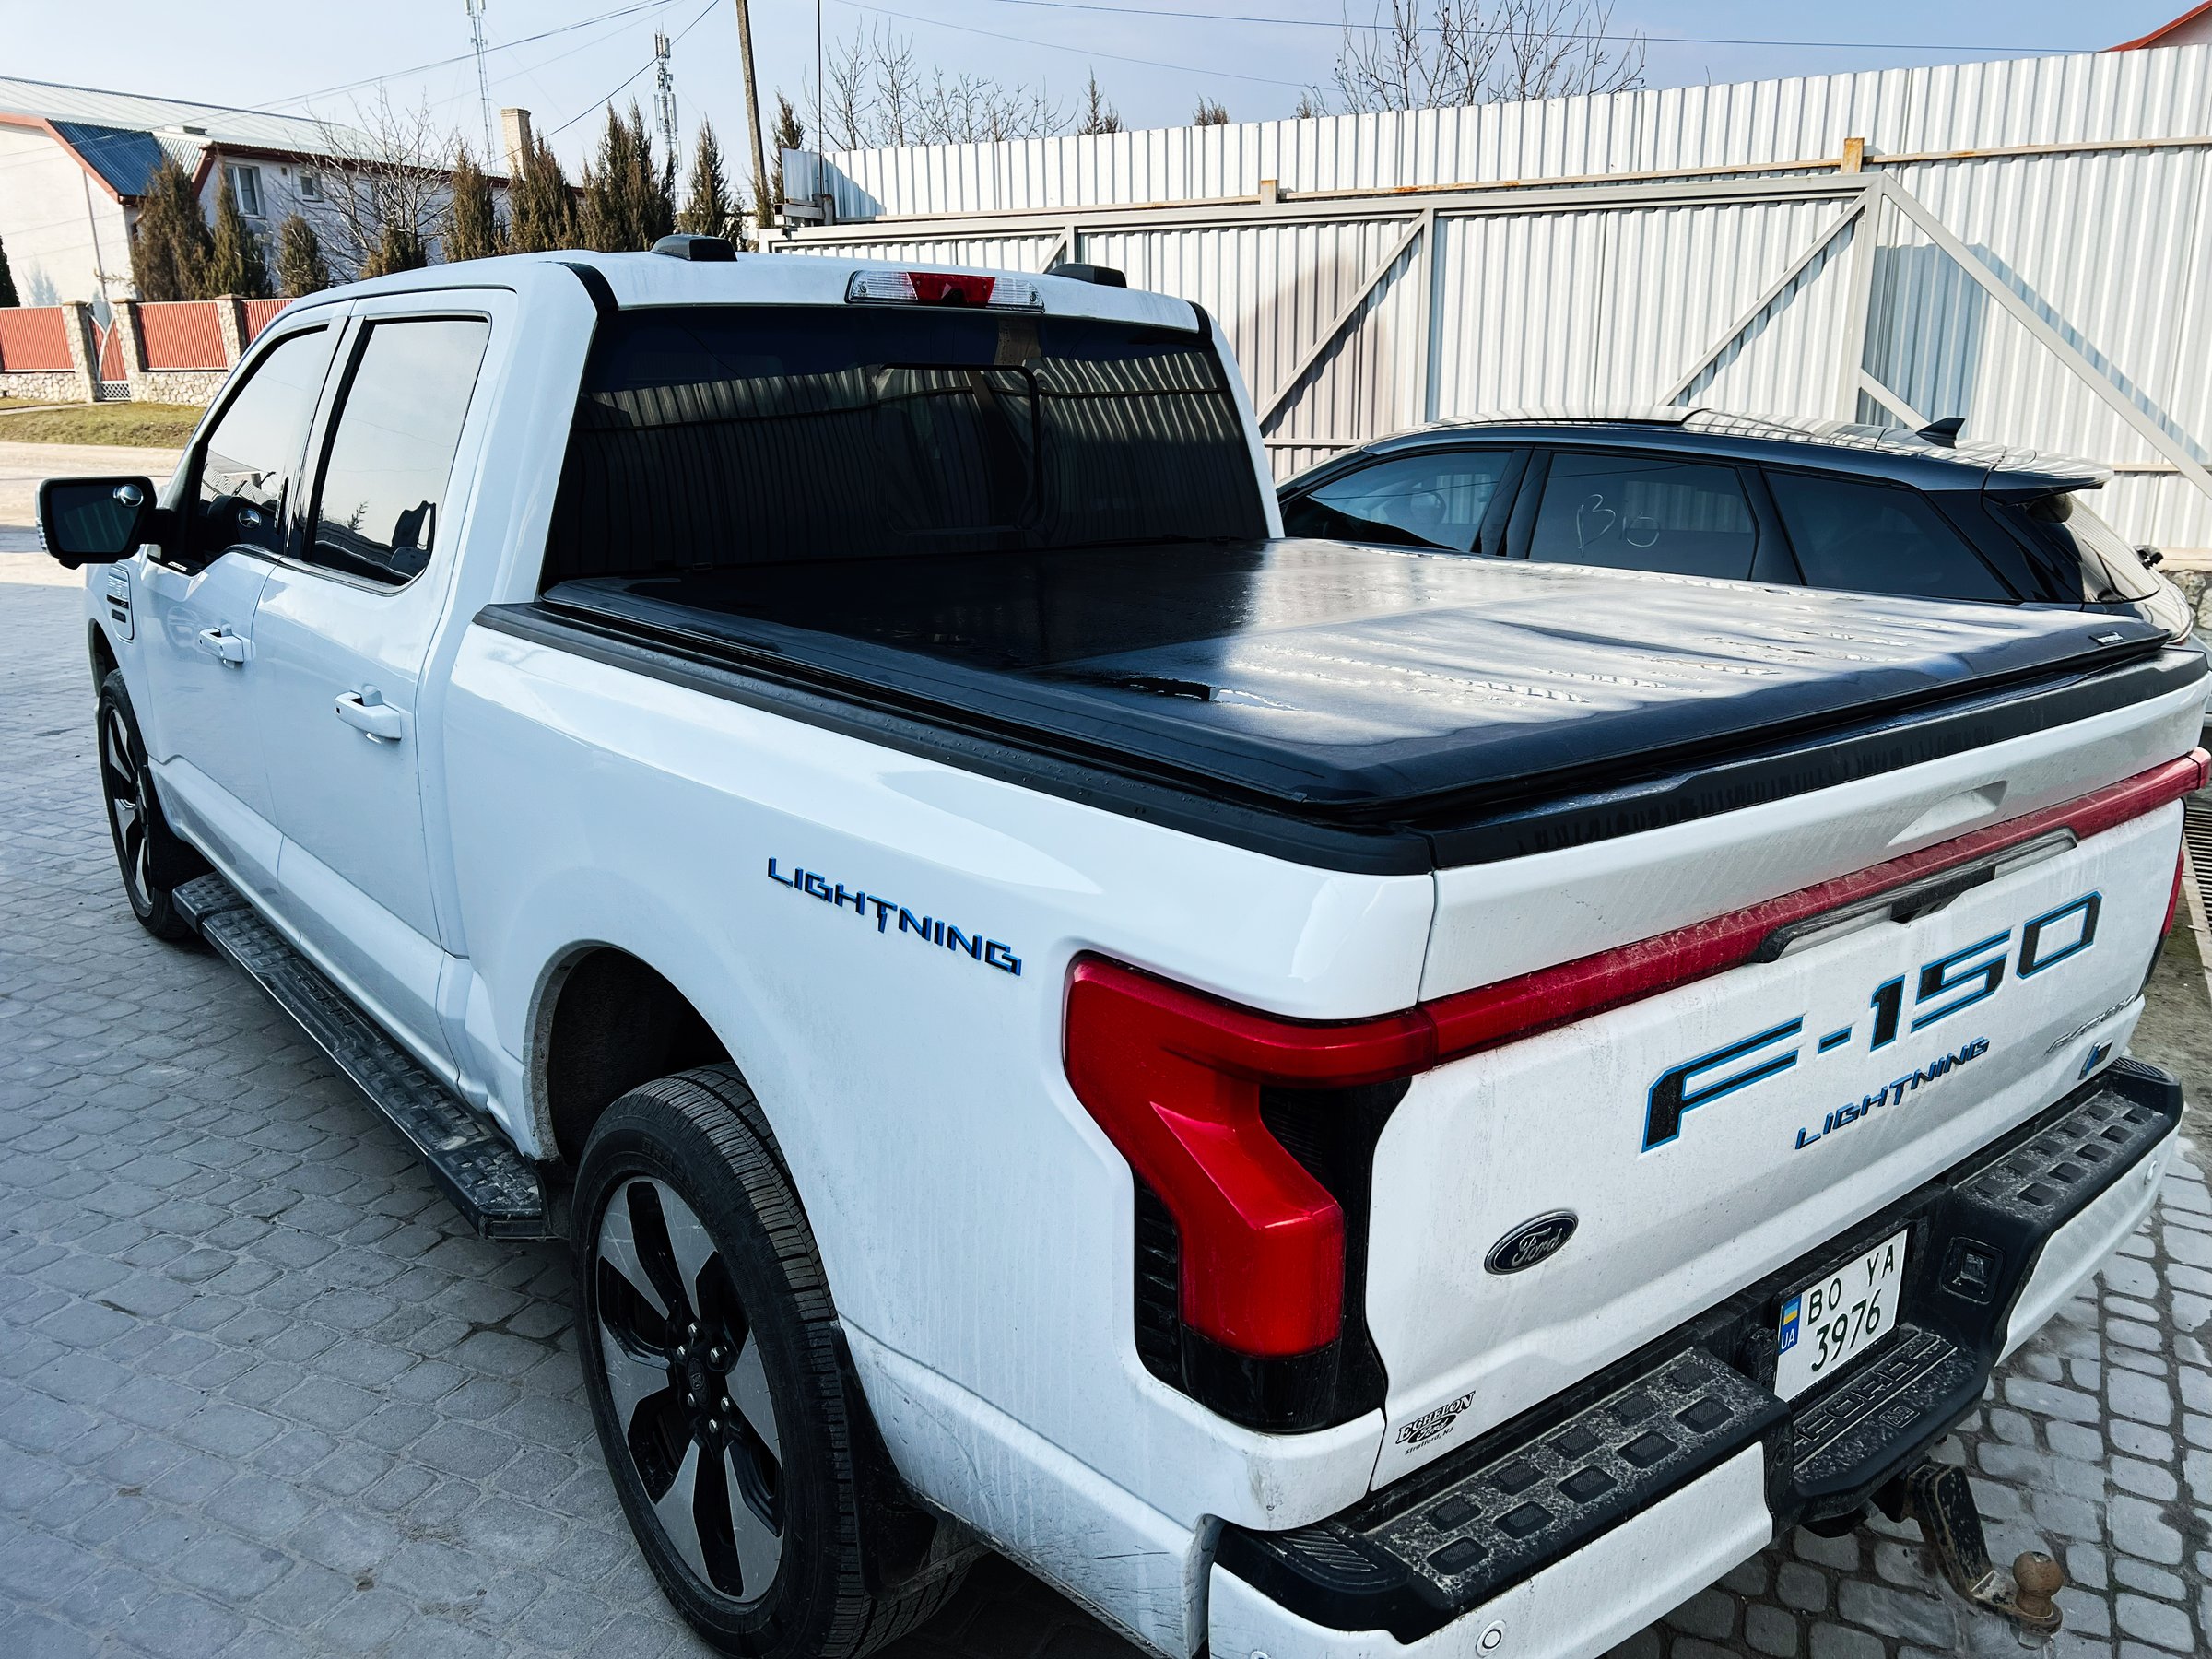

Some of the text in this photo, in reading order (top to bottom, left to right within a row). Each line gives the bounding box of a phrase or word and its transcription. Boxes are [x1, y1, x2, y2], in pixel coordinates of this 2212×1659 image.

[767, 856, 1022, 977] LIGHTNING
[1641, 890, 2102, 1153] F-150
[1795, 1036, 1989, 1150] LIGHTNING
[1512, 1227, 1562, 1266] Ford
[1807, 1244, 1894, 1326] BO YA
[1781, 1328, 1795, 1350] UA
[1811, 1288, 1882, 1371] 3976
[1395, 1390, 1476, 1444] ECHELON
[1794, 1361, 1919, 1445] FORD
